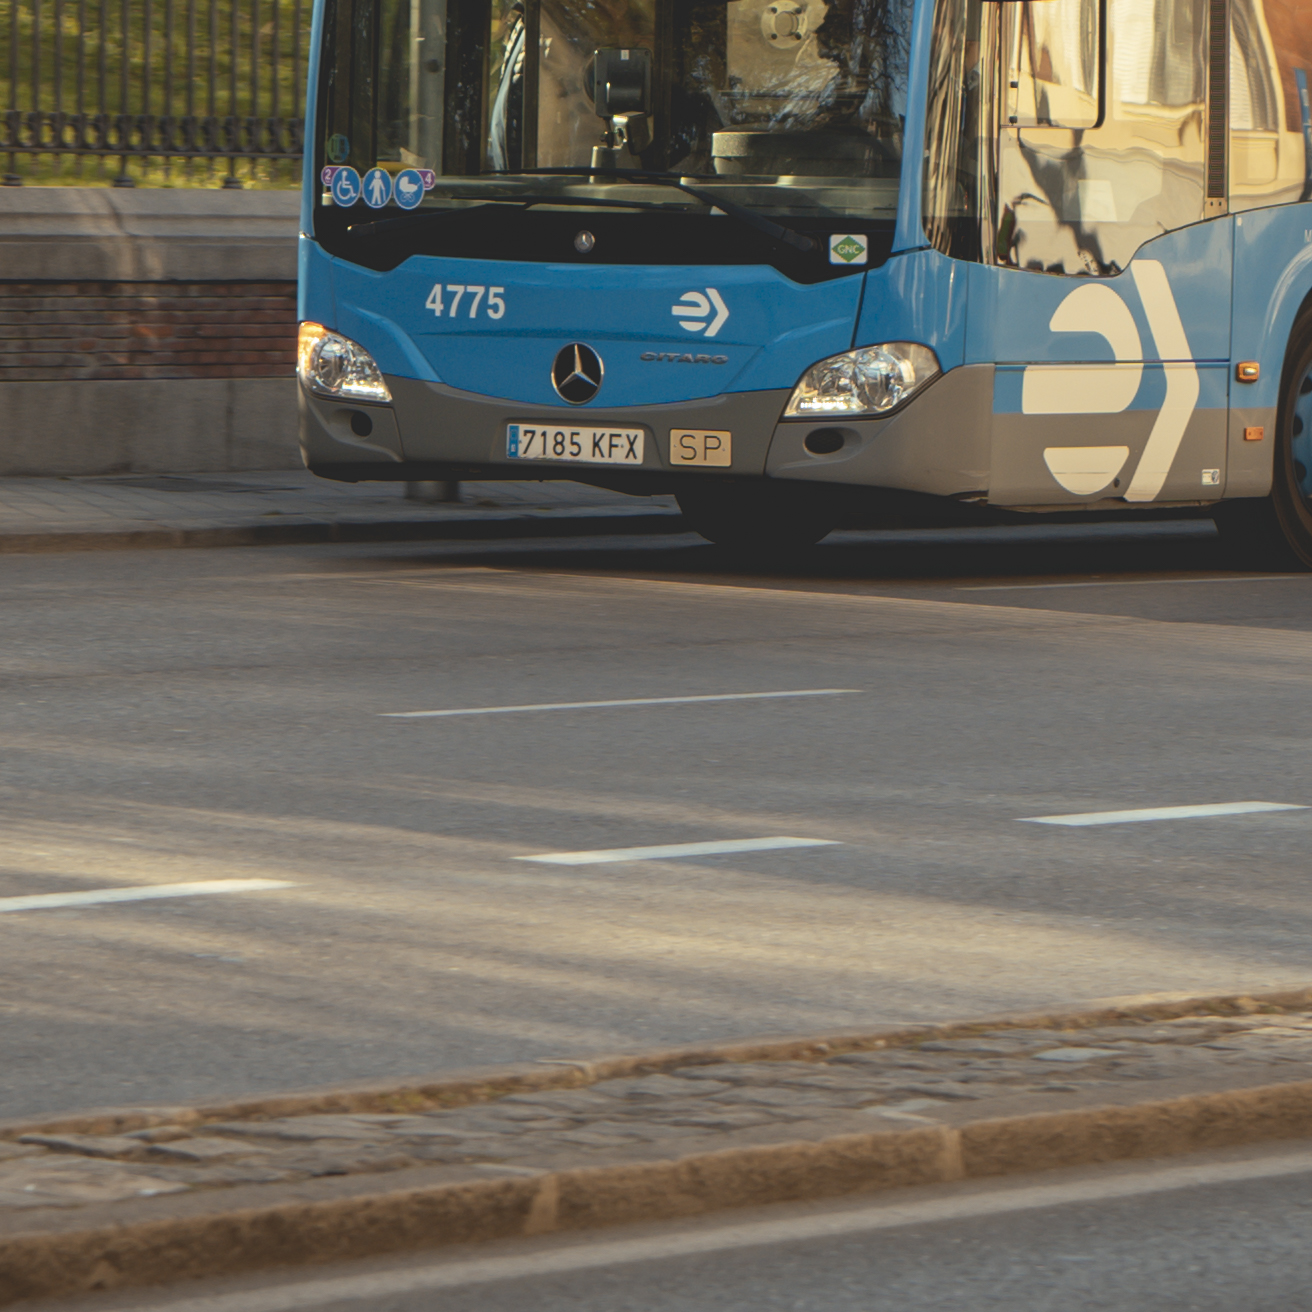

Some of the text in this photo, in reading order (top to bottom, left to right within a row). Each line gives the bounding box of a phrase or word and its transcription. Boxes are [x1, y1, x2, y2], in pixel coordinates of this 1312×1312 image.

[325, 169, 331, 180] 2
[425, 173, 432, 184] 4
[837, 244, 859, 254] GNC
[425, 283, 505, 319] 4775
[640, 352, 729, 364] CITARO
[522, 429, 638, 460] 7185 KFX
[680, 434, 722, 461] SP
